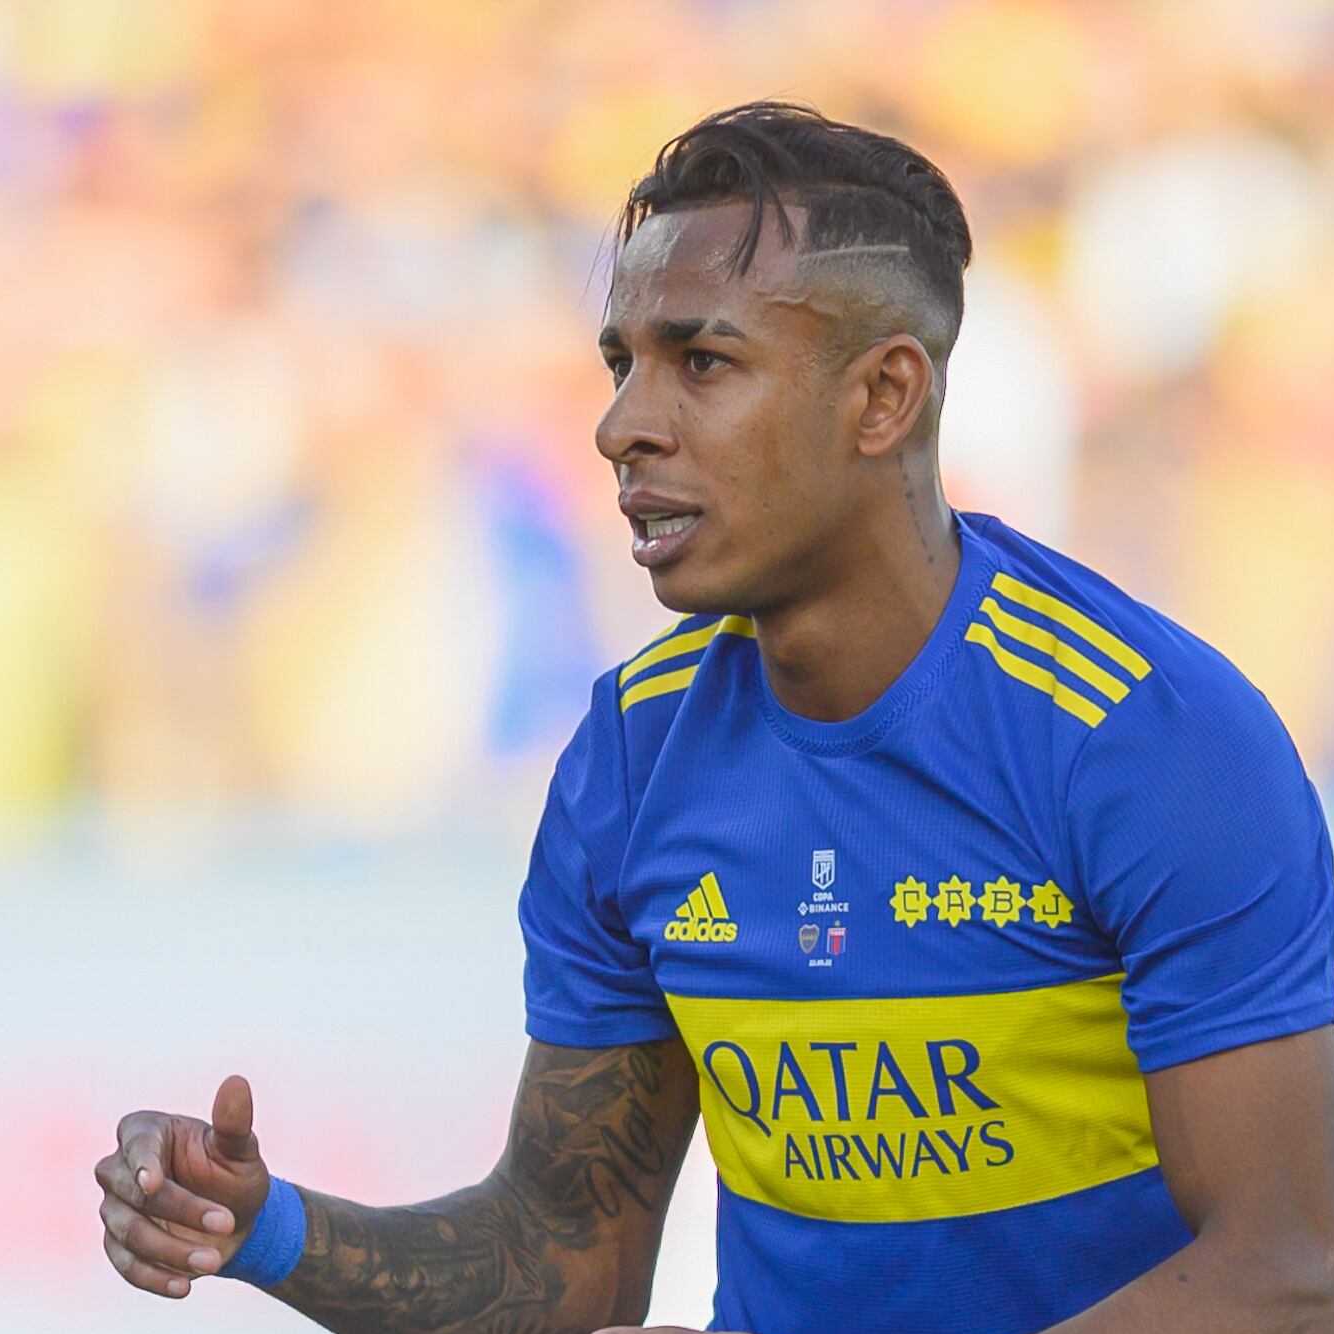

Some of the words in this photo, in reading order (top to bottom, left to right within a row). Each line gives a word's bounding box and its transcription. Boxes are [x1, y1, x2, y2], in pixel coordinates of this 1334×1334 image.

[809, 902, 849, 913] BINANCE
[813, 892, 833, 902] COPA
[663, 918, 739, 943] adidas
[703, 1038, 1003, 1138] QATAR
[784, 1120, 1015, 1181] AIRWAYS
